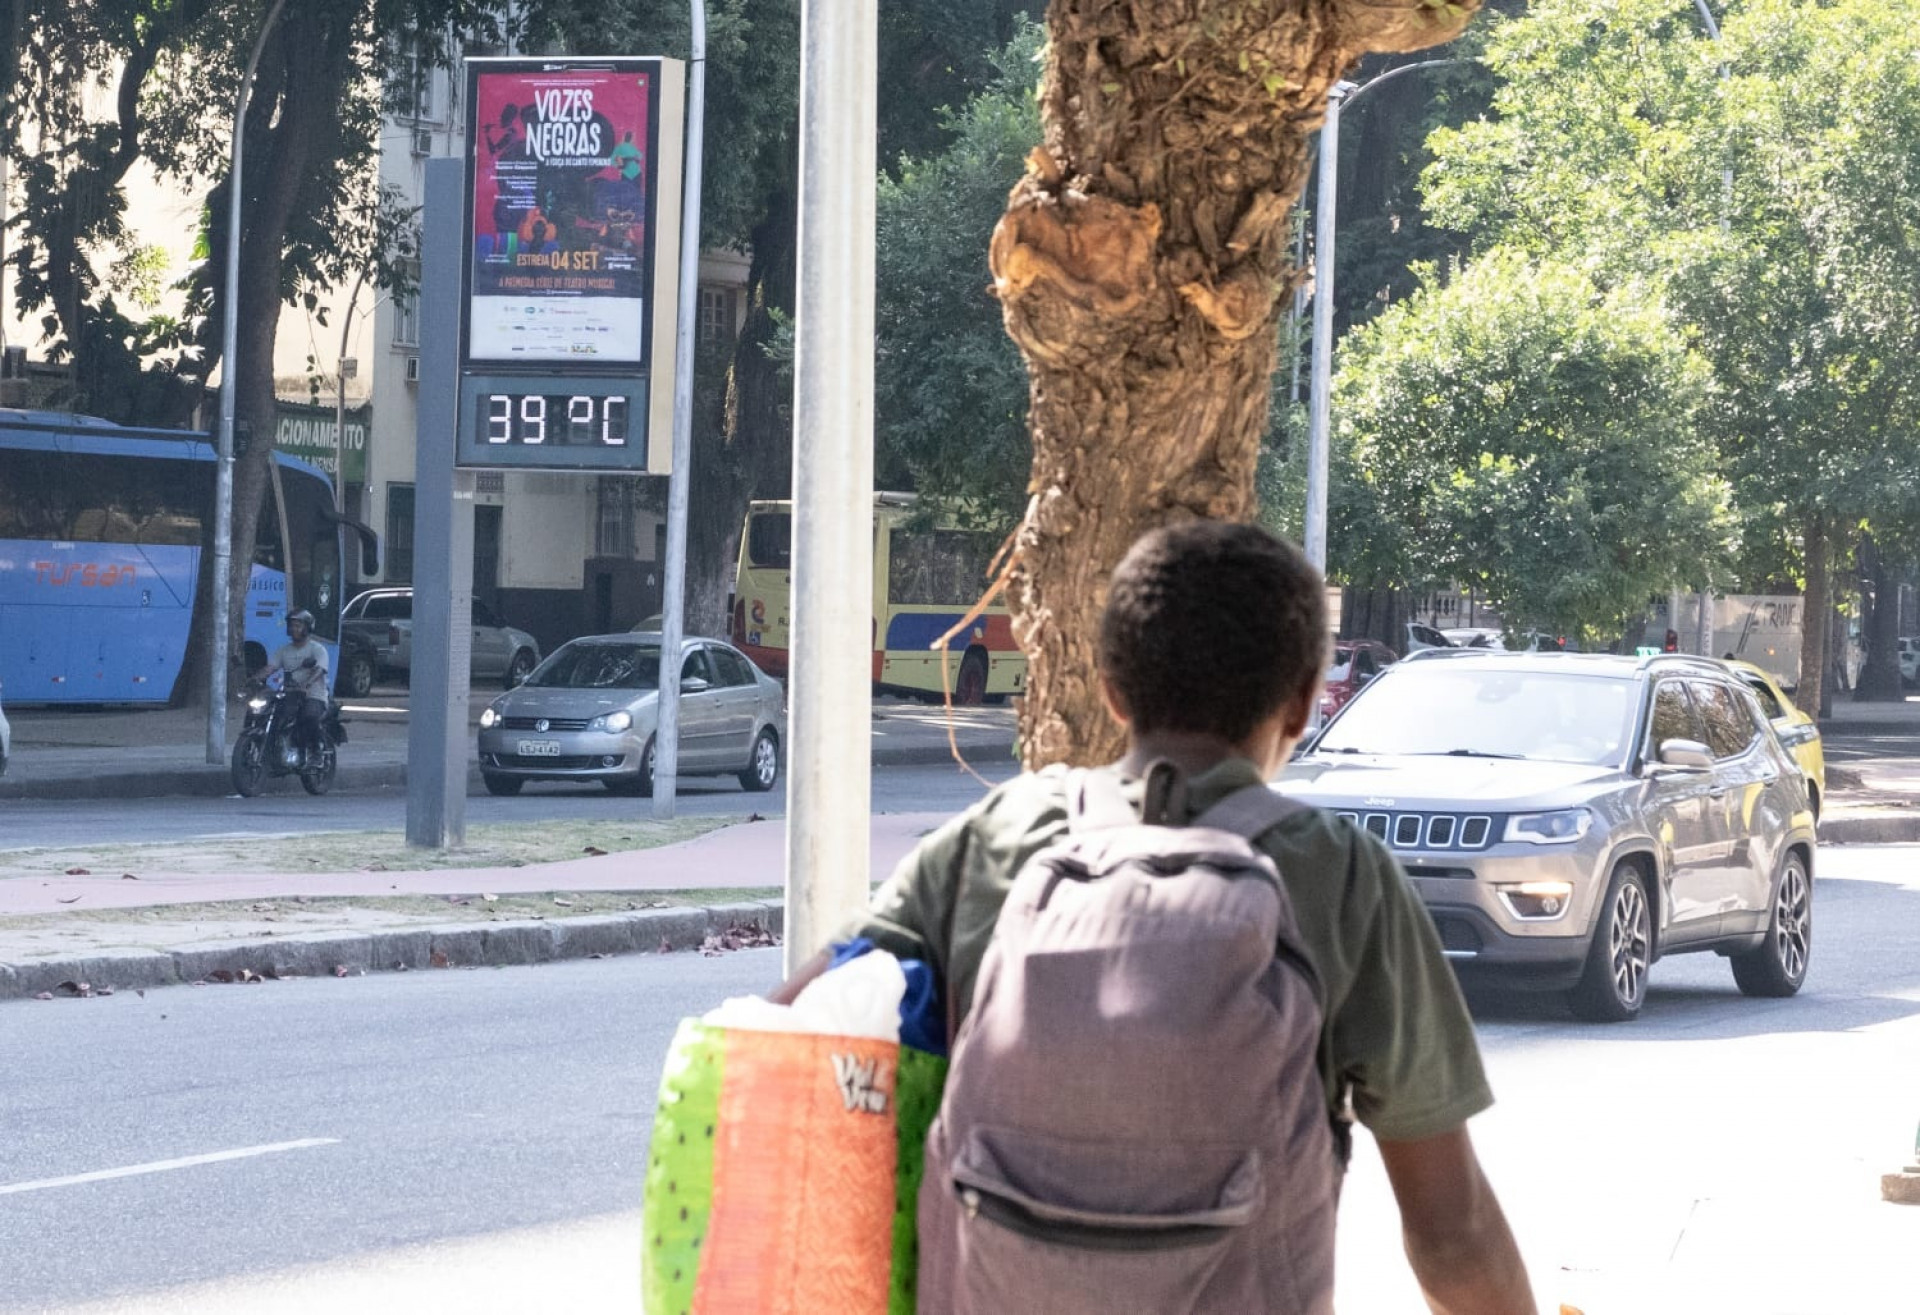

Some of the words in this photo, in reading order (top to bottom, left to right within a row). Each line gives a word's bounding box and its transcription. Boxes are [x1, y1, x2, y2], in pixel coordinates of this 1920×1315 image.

[534, 88, 593, 122] VOZES
[525, 122, 601, 161] NEGRAS
[516, 253, 550, 267] ESTREIA
[551, 251, 569, 271] 04
[573, 251, 599, 271] SET
[505, 276, 534, 288] PRIMEIRA
[565, 278, 586, 290] TEATRO
[588, 278, 615, 290] MUSICAL
[489, 395, 546, 444] 39
[1363, 796, 1396, 808] Jeep
